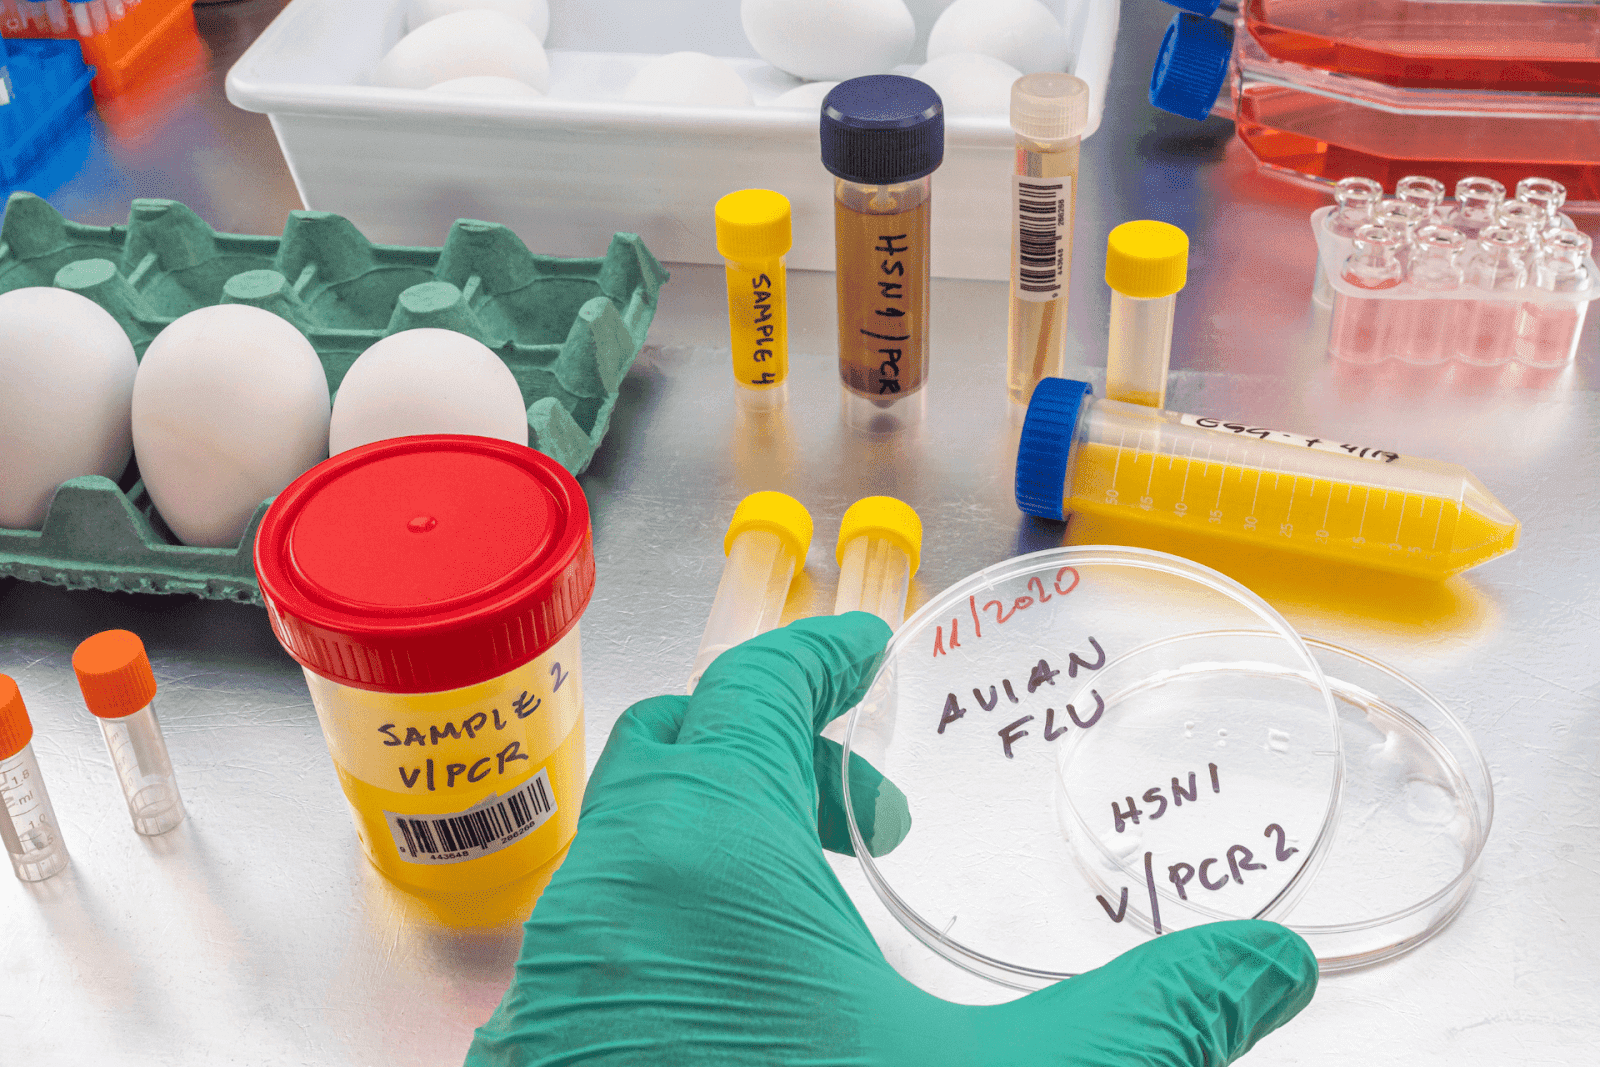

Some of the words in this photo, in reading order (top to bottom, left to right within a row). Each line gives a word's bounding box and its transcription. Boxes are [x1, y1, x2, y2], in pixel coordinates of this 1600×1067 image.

[752, 273, 774, 362] SAMPLE
[752, 372, 776, 385] 4
[1105, 489, 1119, 505] 50
[1173, 502, 1188, 517] 40
[1208, 509, 1223, 524] 35
[1243, 516, 1258, 531] 30
[1279, 523, 1293, 538] 25
[1315, 529, 1329, 545] 20
[933, 566, 1080, 657] 11/2020
[937, 636, 1106, 734] AVIAN
[378, 690, 542, 747] SAMPLE
[550, 662, 569, 693] 2
[998, 689, 1105, 759] FLU
[11, 769, 30, 785] 1.8
